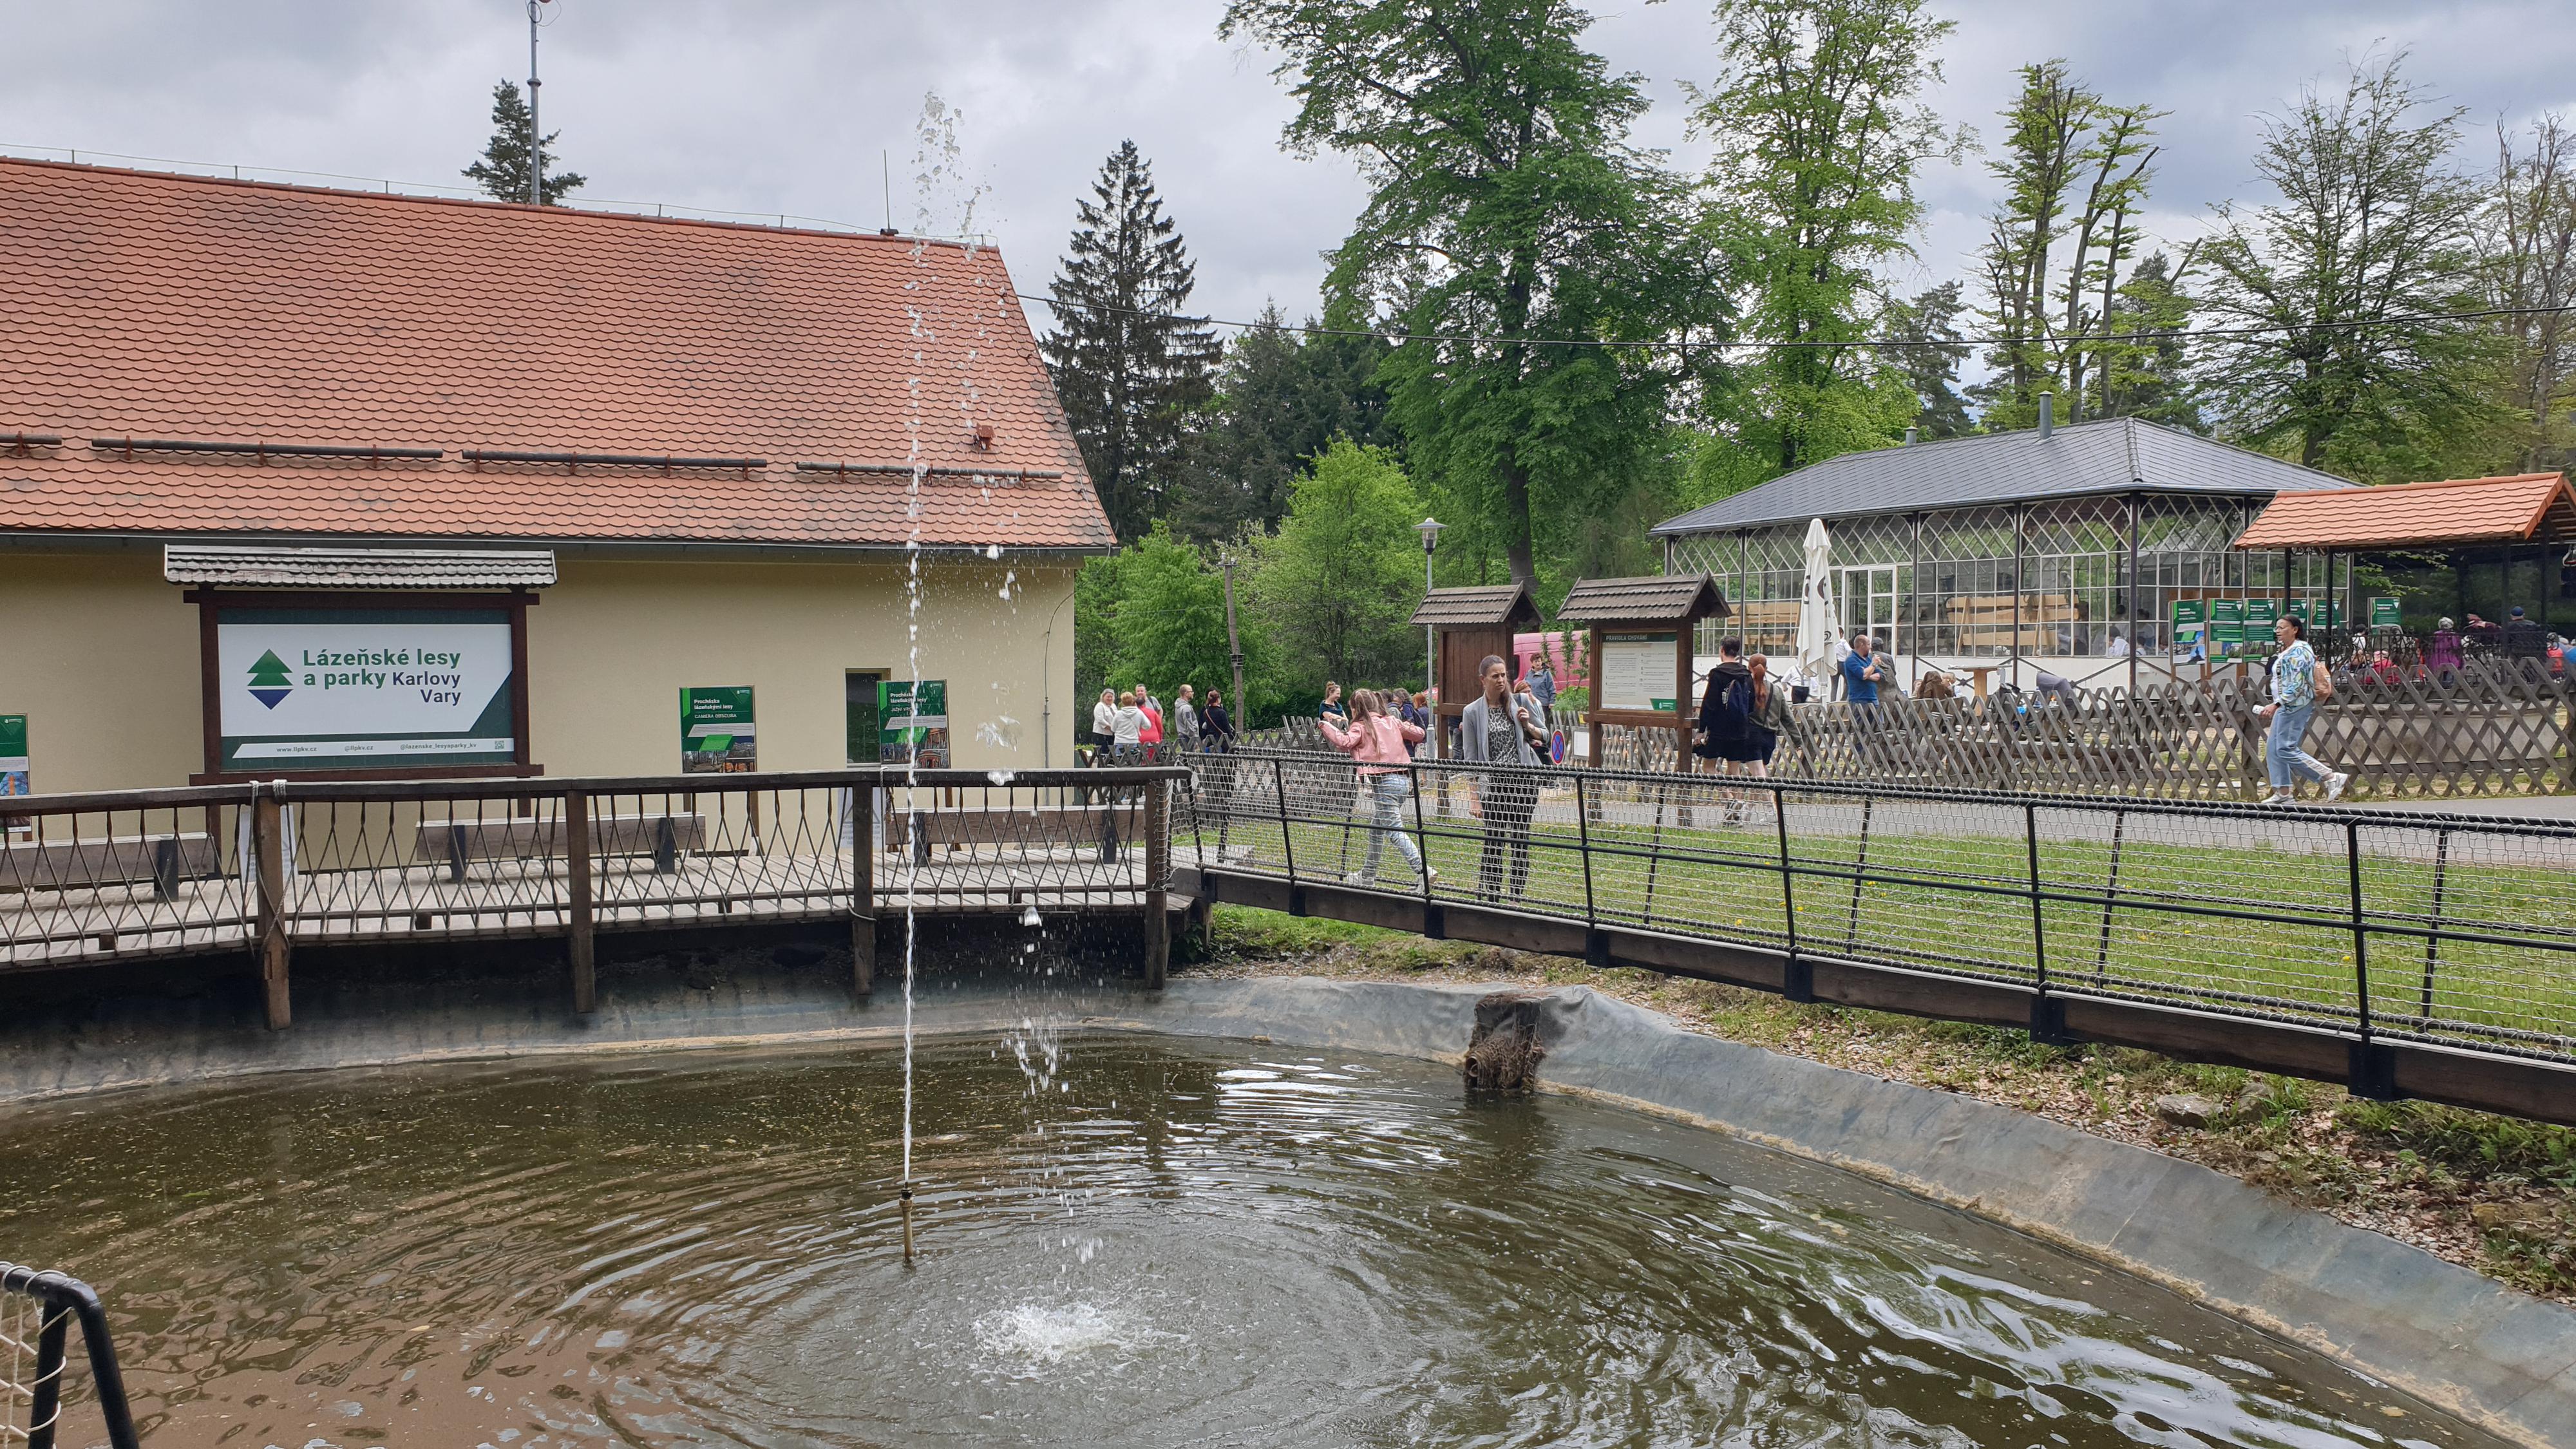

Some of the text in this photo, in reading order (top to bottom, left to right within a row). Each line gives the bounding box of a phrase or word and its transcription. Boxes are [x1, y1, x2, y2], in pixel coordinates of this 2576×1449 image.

[303, 649, 461, 669] Lázeňské lesy
[304, 668, 461, 690] a parky Karlovy
[421, 689, 461, 706] Vary
